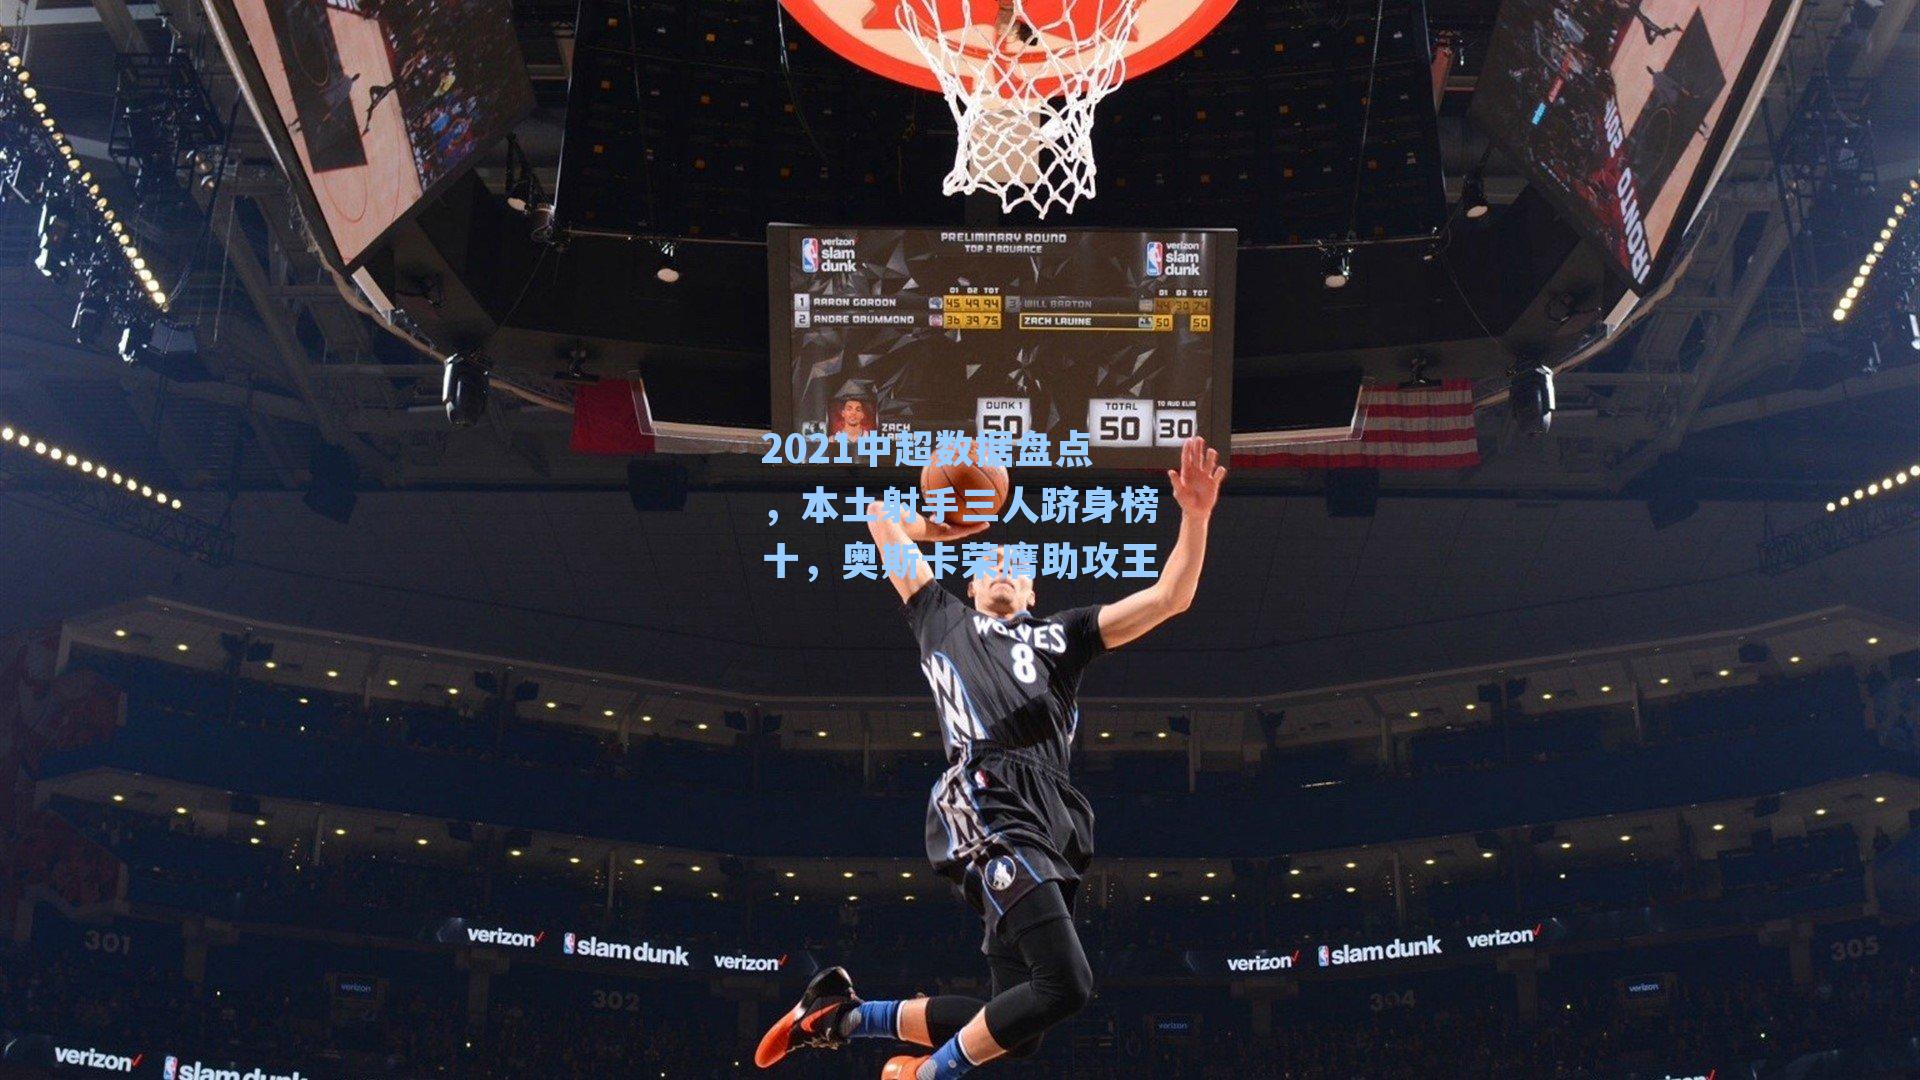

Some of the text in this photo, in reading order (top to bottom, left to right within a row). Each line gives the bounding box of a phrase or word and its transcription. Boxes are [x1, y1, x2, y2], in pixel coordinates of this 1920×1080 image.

[821, 237, 855, 246] verizon
[940, 232, 1067, 244] PRELIMINARY ROUND
[965, 244, 1043, 254] TOP 2 ADVANCE
[1165, 241, 1200, 250] verizon
[821, 246, 856, 260] slam
[1165, 250, 1200, 263] slam
[821, 260, 857, 272] dunk
[1164, 263, 1200, 276] dunk
[813, 297, 850, 307] AARON
[853, 297, 897, 307] GORDON
[946, 299, 960, 308] 45
[965, 299, 980, 308] 49
[983, 299, 999, 308] 94
[1050, 299, 1092, 308] BARTON
[799, 314, 806, 324] 2
[813, 315, 850, 324] ANDRE
[852, 315, 915, 324] DRUMMOND
[965, 316, 980, 325] 39
[983, 316, 999, 325] 75
[1024, 317, 1208, 327] ZACH LAVINE 50 50
[986, 402, 1016, 410] DUNK
[1105, 402, 1138, 411] TOTAL
[983, 415, 1023, 438] 50
[1100, 416, 1141, 441] 50
[1160, 418, 1193, 438] 30
[973, 616, 1067, 654] WOLVES
[1011, 643, 1037, 684] 8
[85, 929, 131, 955] 301
[1831, 935, 1880, 961] 305
[467, 928, 779, 972] verizon slam dunk verizon
[1227, 929, 1534, 971] verizon slam dunk verizon
[340, 983, 372, 993] verizon
[1628, 983, 1660, 993] verizon
[592, 988, 640, 1012] 302
[54, 1047, 132, 1072] verizon
